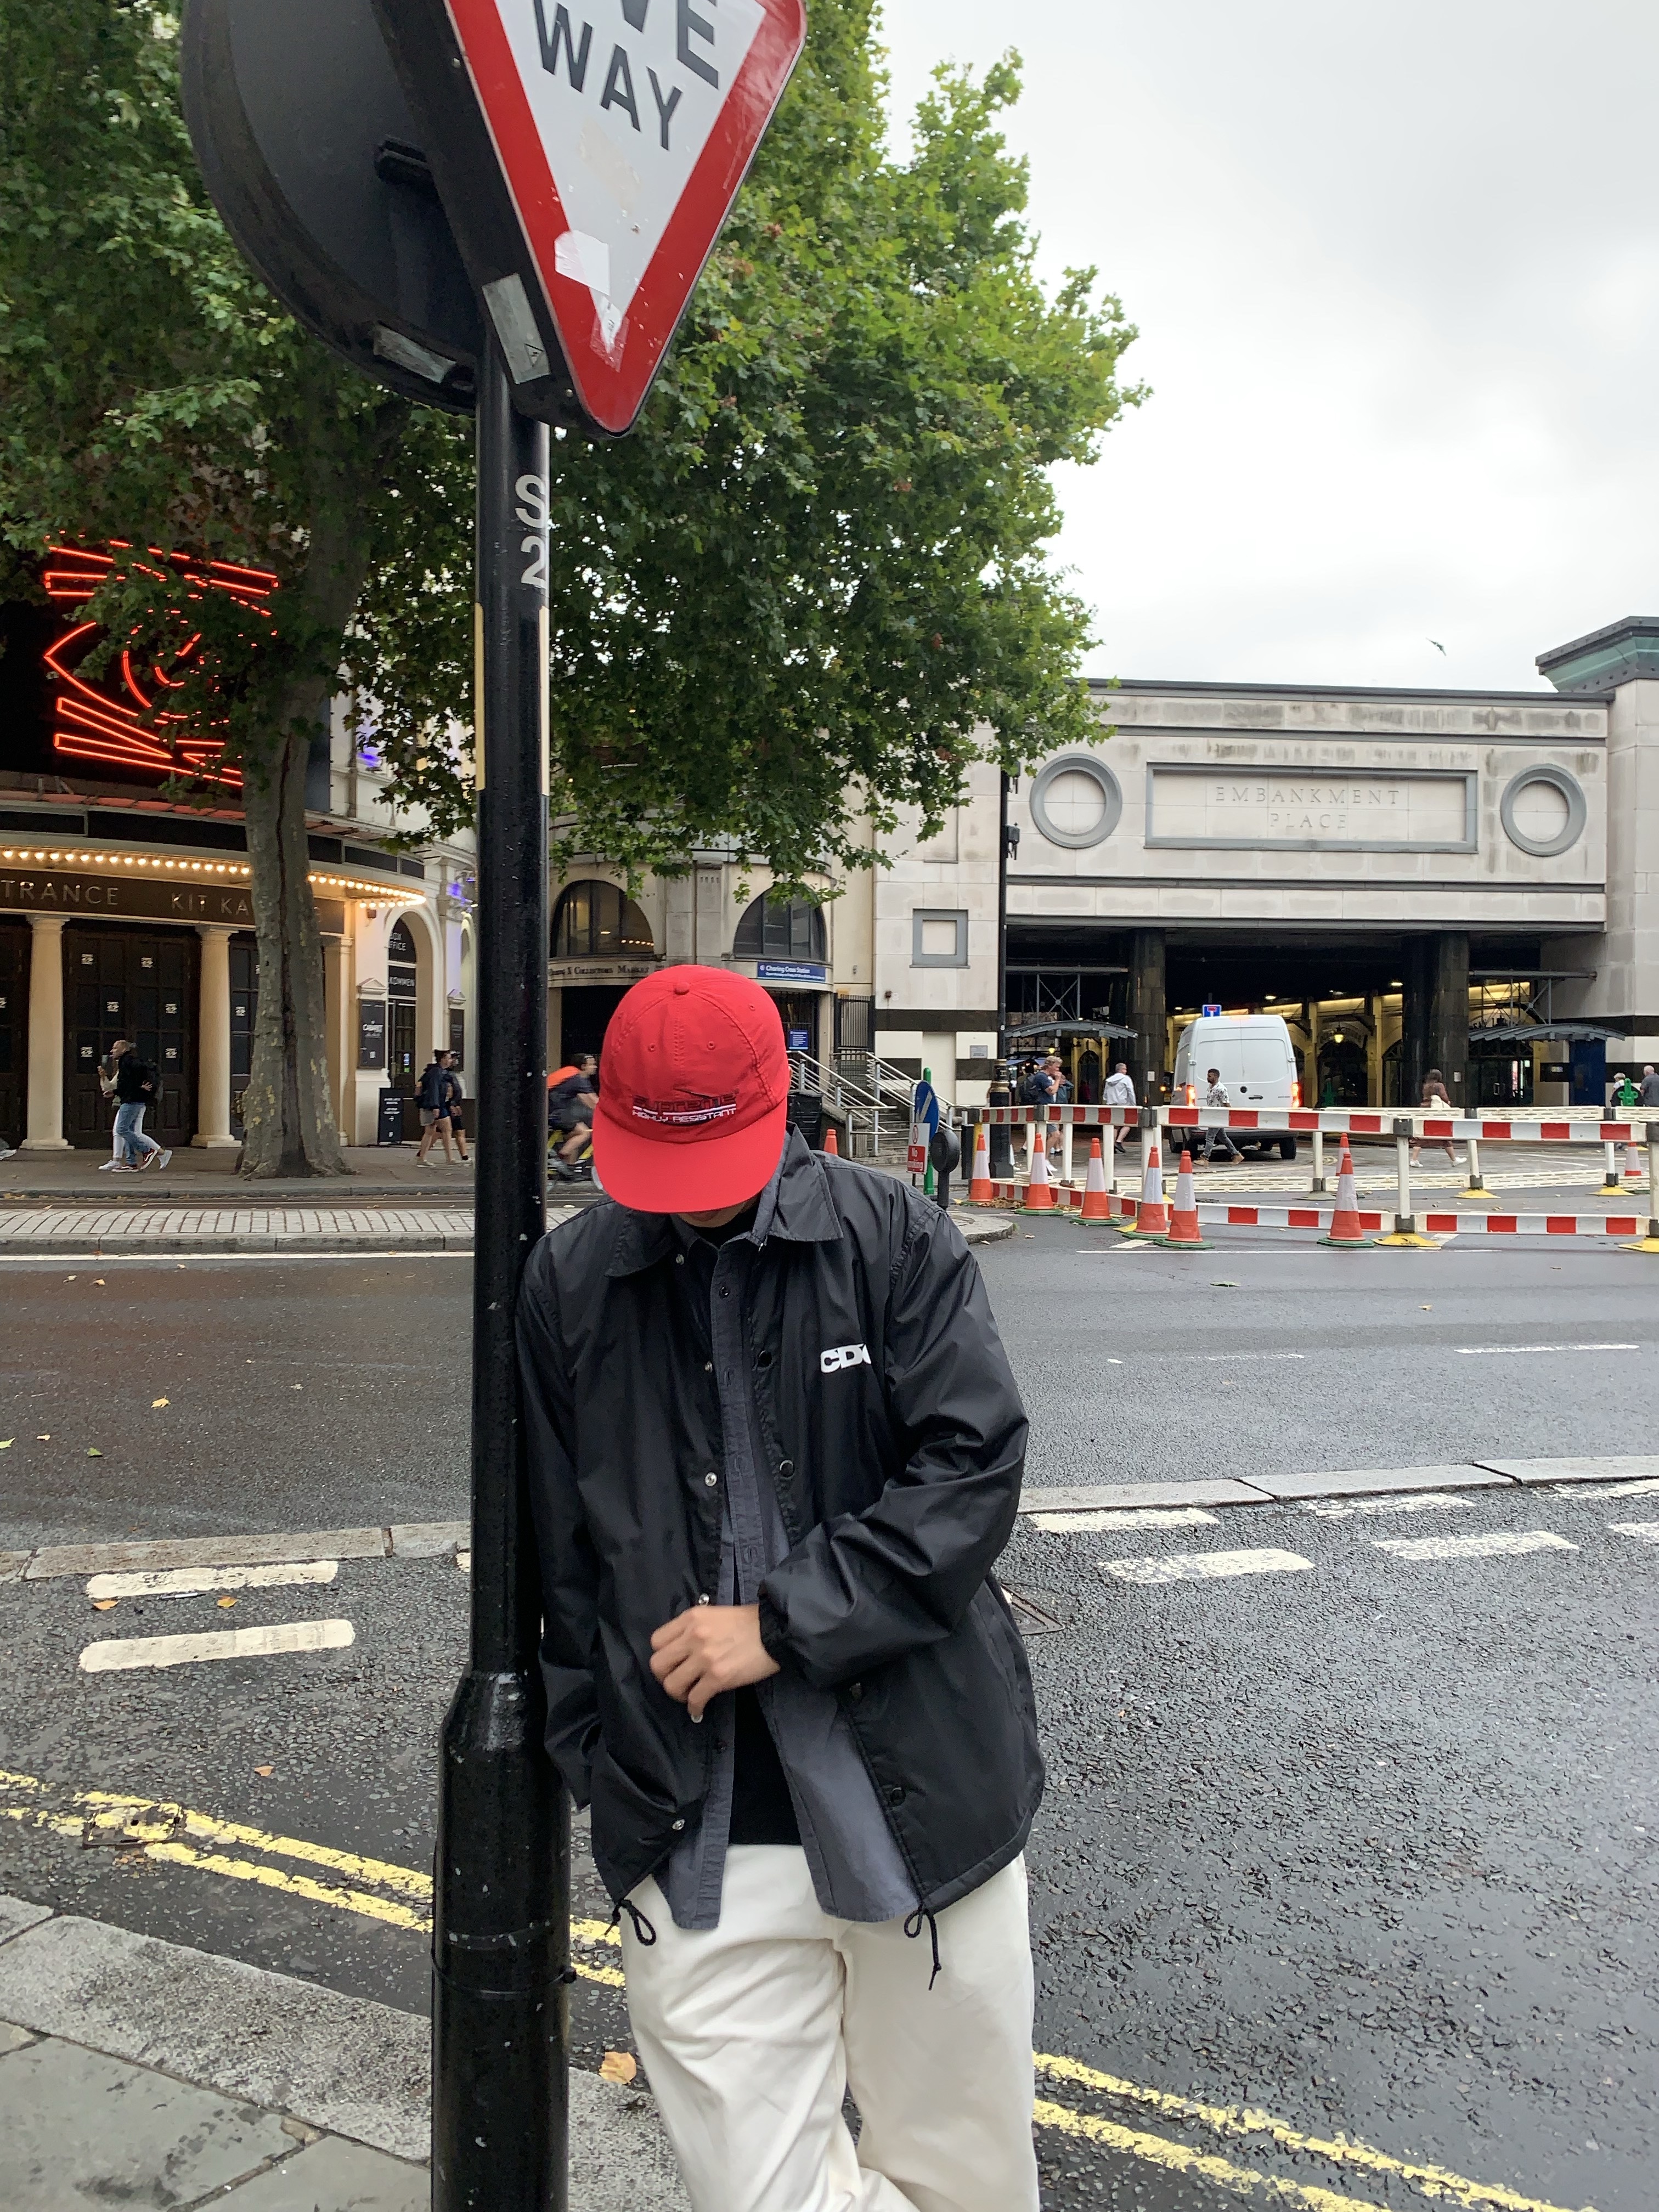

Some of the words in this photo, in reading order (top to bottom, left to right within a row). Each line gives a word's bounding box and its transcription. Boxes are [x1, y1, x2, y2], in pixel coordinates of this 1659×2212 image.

[533, 0, 683, 150] WAY
[1215, 787, 1399, 804] EMBANKMENT
[1270, 812, 1347, 828] PLACE
[171, 894, 208, 911] KIT
[221, 898, 249, 916] KA
[631, 1109, 669, 1122] HIGHLY
[673, 1108, 736, 1122] RESISTANT
